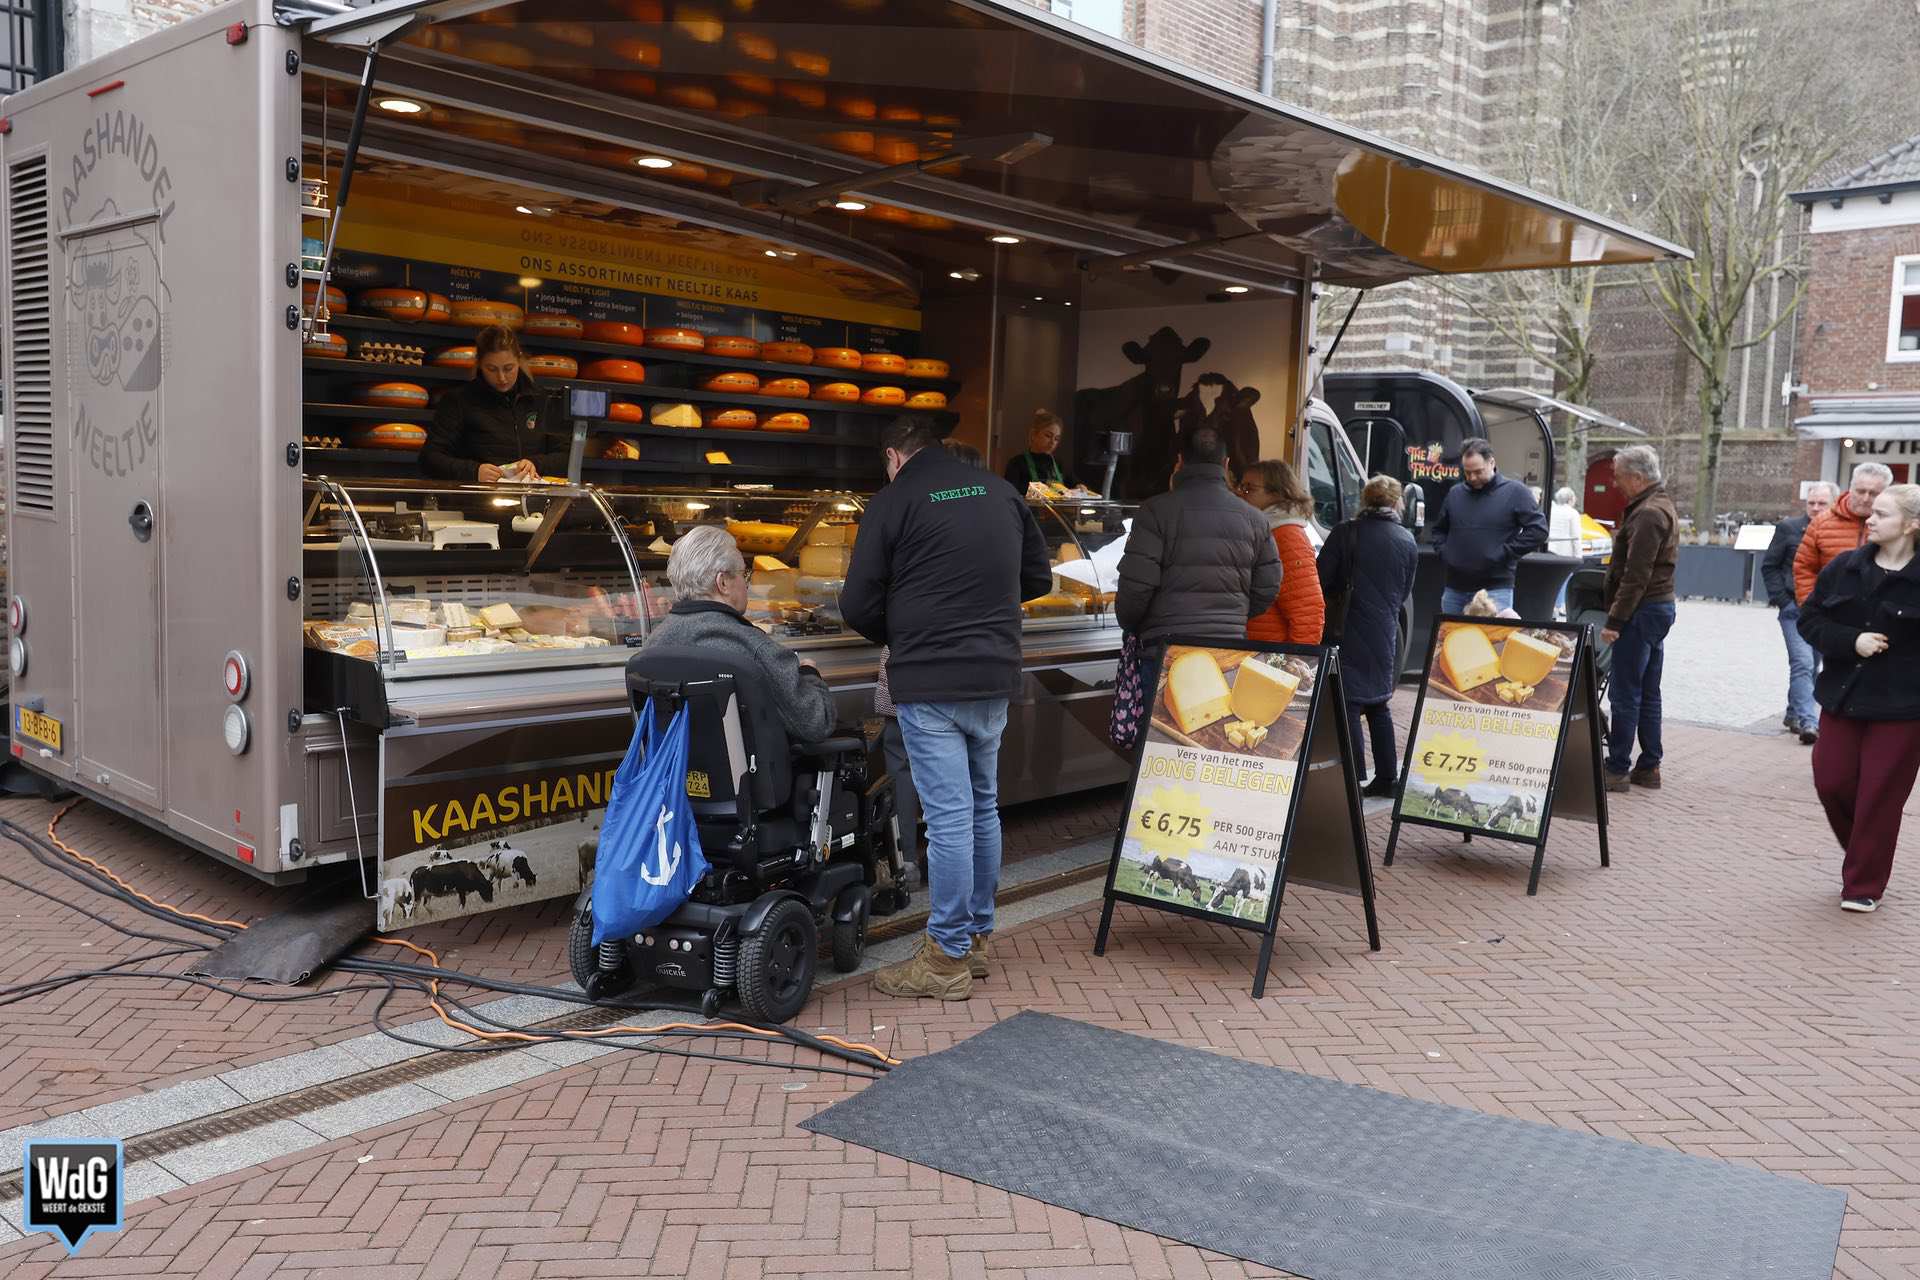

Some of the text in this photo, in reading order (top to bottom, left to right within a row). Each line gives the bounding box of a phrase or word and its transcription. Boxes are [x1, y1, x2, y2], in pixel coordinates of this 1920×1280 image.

[520, 255, 760, 303] ONS ASSORTIMENT NEELTJE KAAS
[74, 400, 157, 478] NEELTJE
[1407, 446, 1427, 463] THE
[928, 486, 987, 503] NEELTJE
[1453, 703, 1531, 720] Vers van het mes
[1424, 709, 1559, 741] EXTRA BELEGEN
[1177, 748, 1265, 770] Vers van het mes
[1422, 751, 1478, 773] € 7,75
[1488, 759, 1506, 769] PER
[1508, 762, 1524, 772] 500
[1141, 756, 1292, 796] JONG BELEGEN
[1488, 774, 1511, 785] AAN
[1522, 779, 1548, 791] STUK
[1140, 809, 1202, 838] € 6,75
[1213, 820, 1232, 833] PER
[1235, 825, 1254, 837] 500
[1213, 840, 1238, 854] AAN
[1250, 846, 1280, 861] STUK
